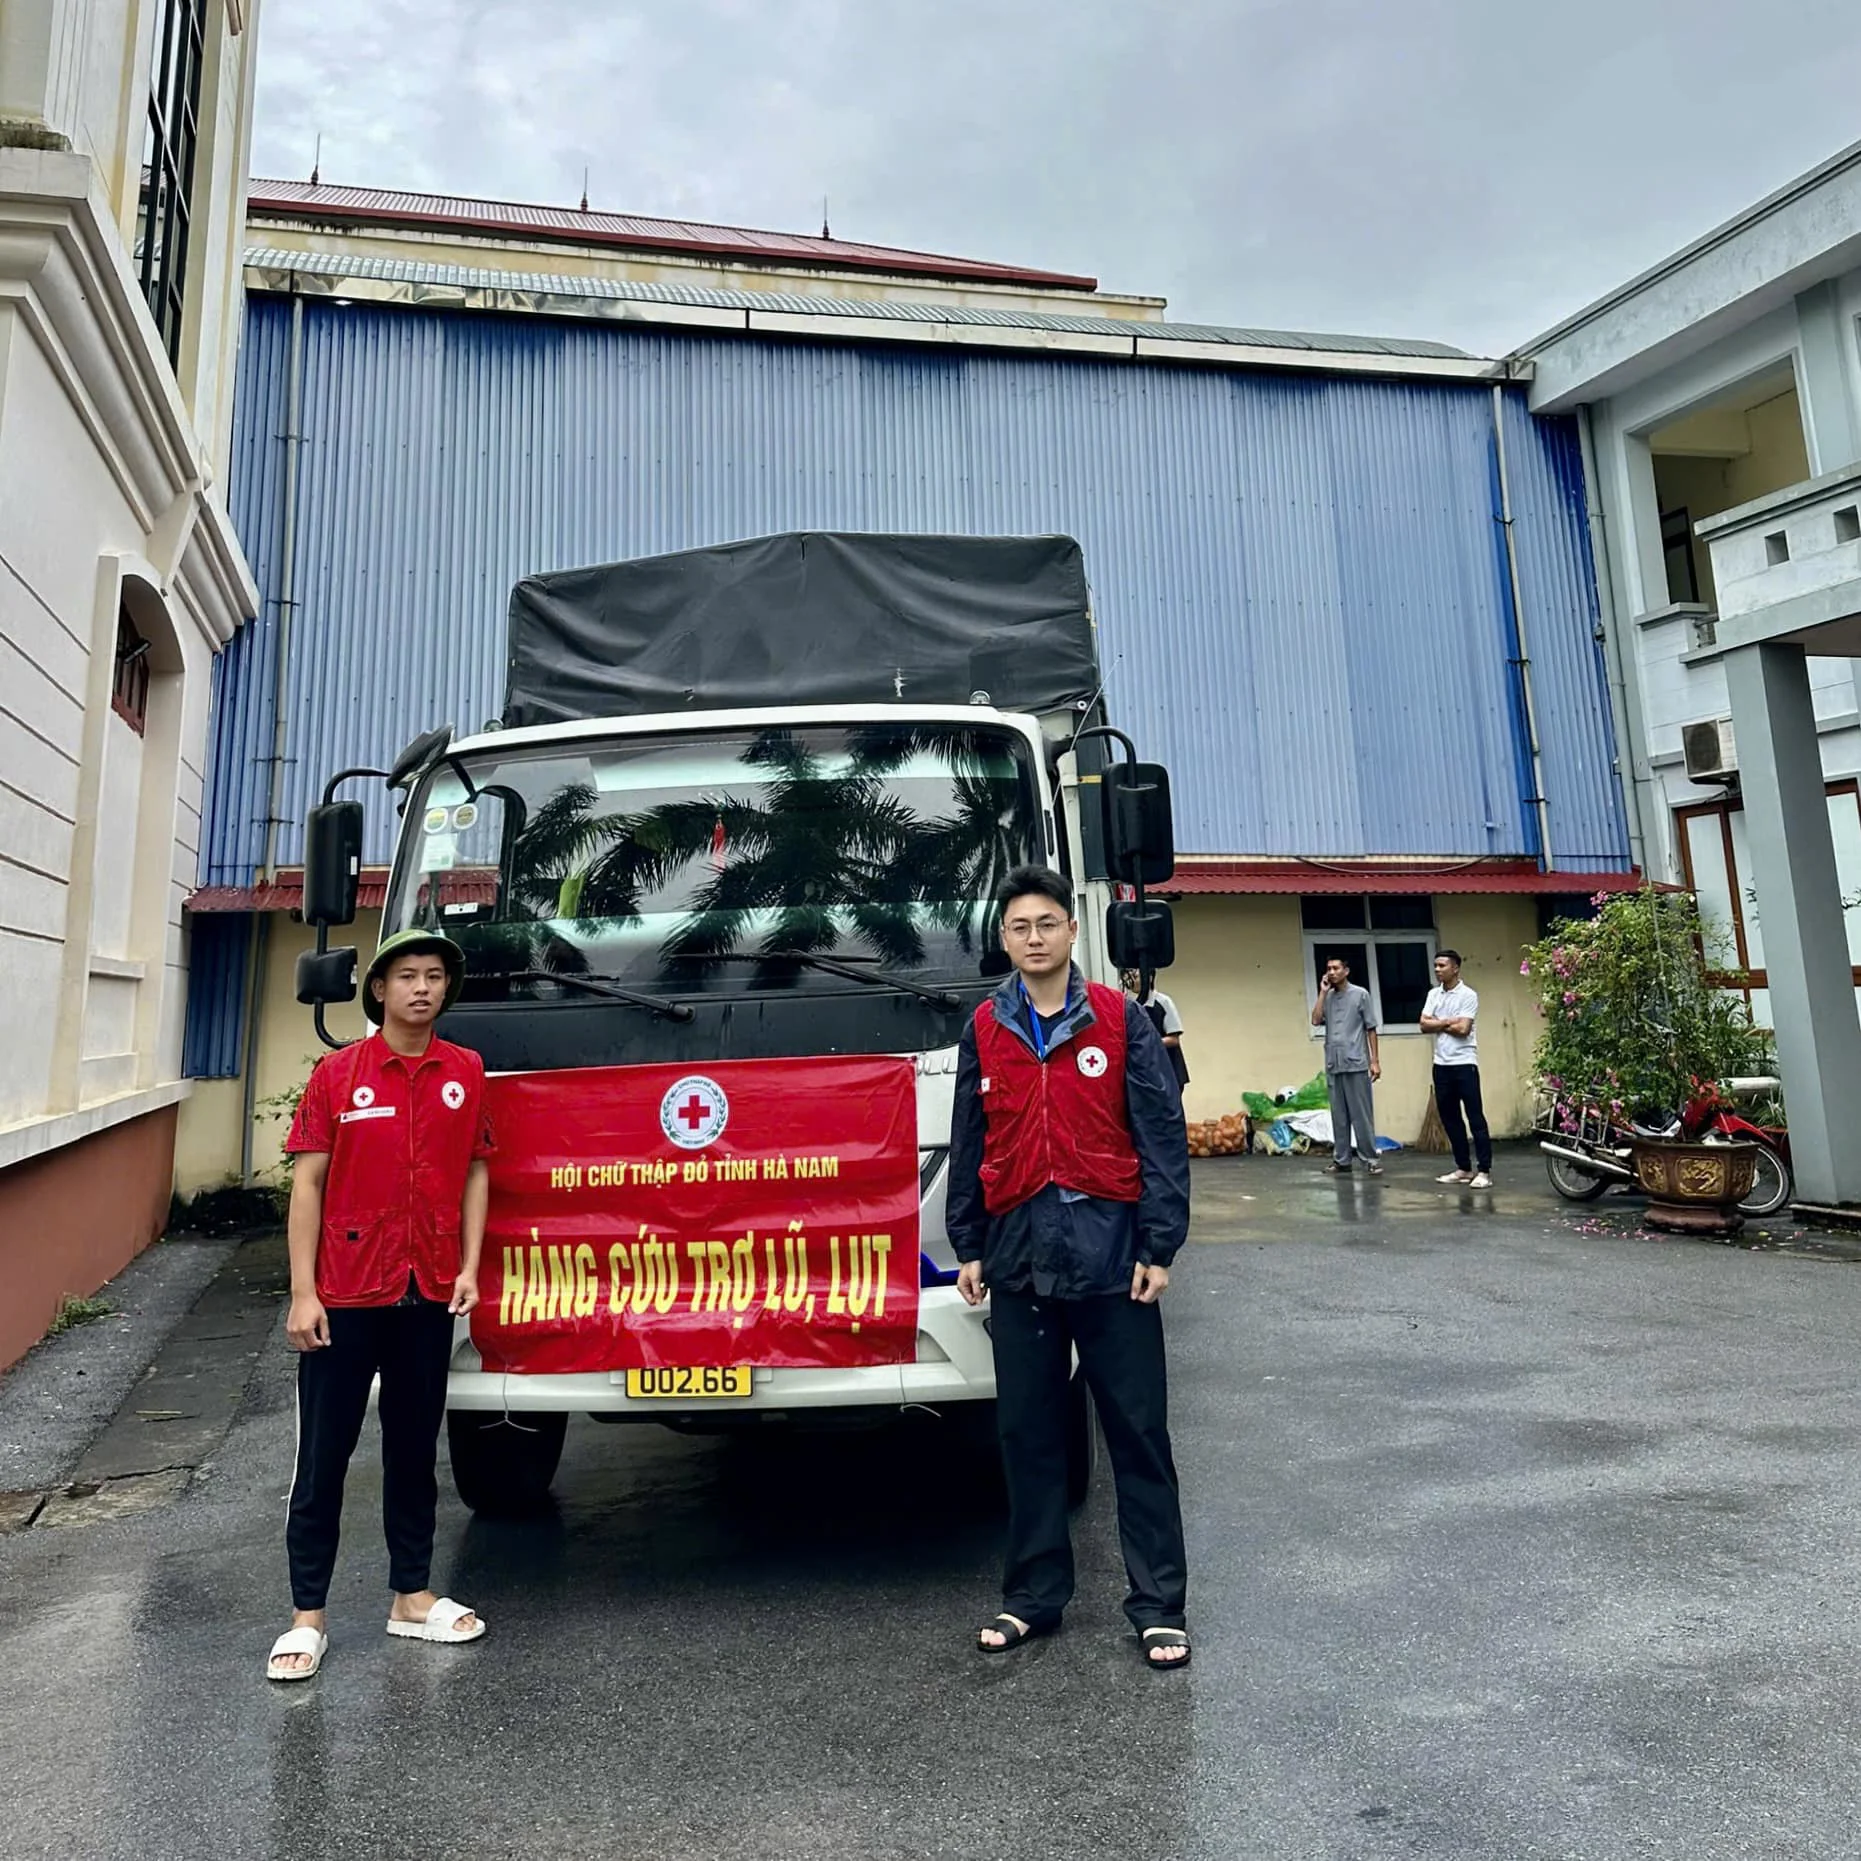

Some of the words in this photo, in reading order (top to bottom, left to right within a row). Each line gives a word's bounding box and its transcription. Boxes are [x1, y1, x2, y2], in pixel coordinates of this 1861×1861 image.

[551, 1162, 582, 1192] HỘI
[588, 1161, 628, 1186] CHỮ
[630, 1158, 678, 1188] THẬP
[683, 1154, 709, 1183] ĐỎ
[714, 1153, 757, 1181] TỈNH
[763, 1153, 789, 1179] HÀ
[794, 1156, 838, 1178] NAM
[500, 1227, 598, 1325] HÀNG
[609, 1224, 679, 1314] CỨU
[687, 1230, 756, 1329] TRỢ
[764, 1220, 816, 1324] LŨ,
[826, 1234, 892, 1334] LỤT
[640, 1366, 737, 1394] 002.66
